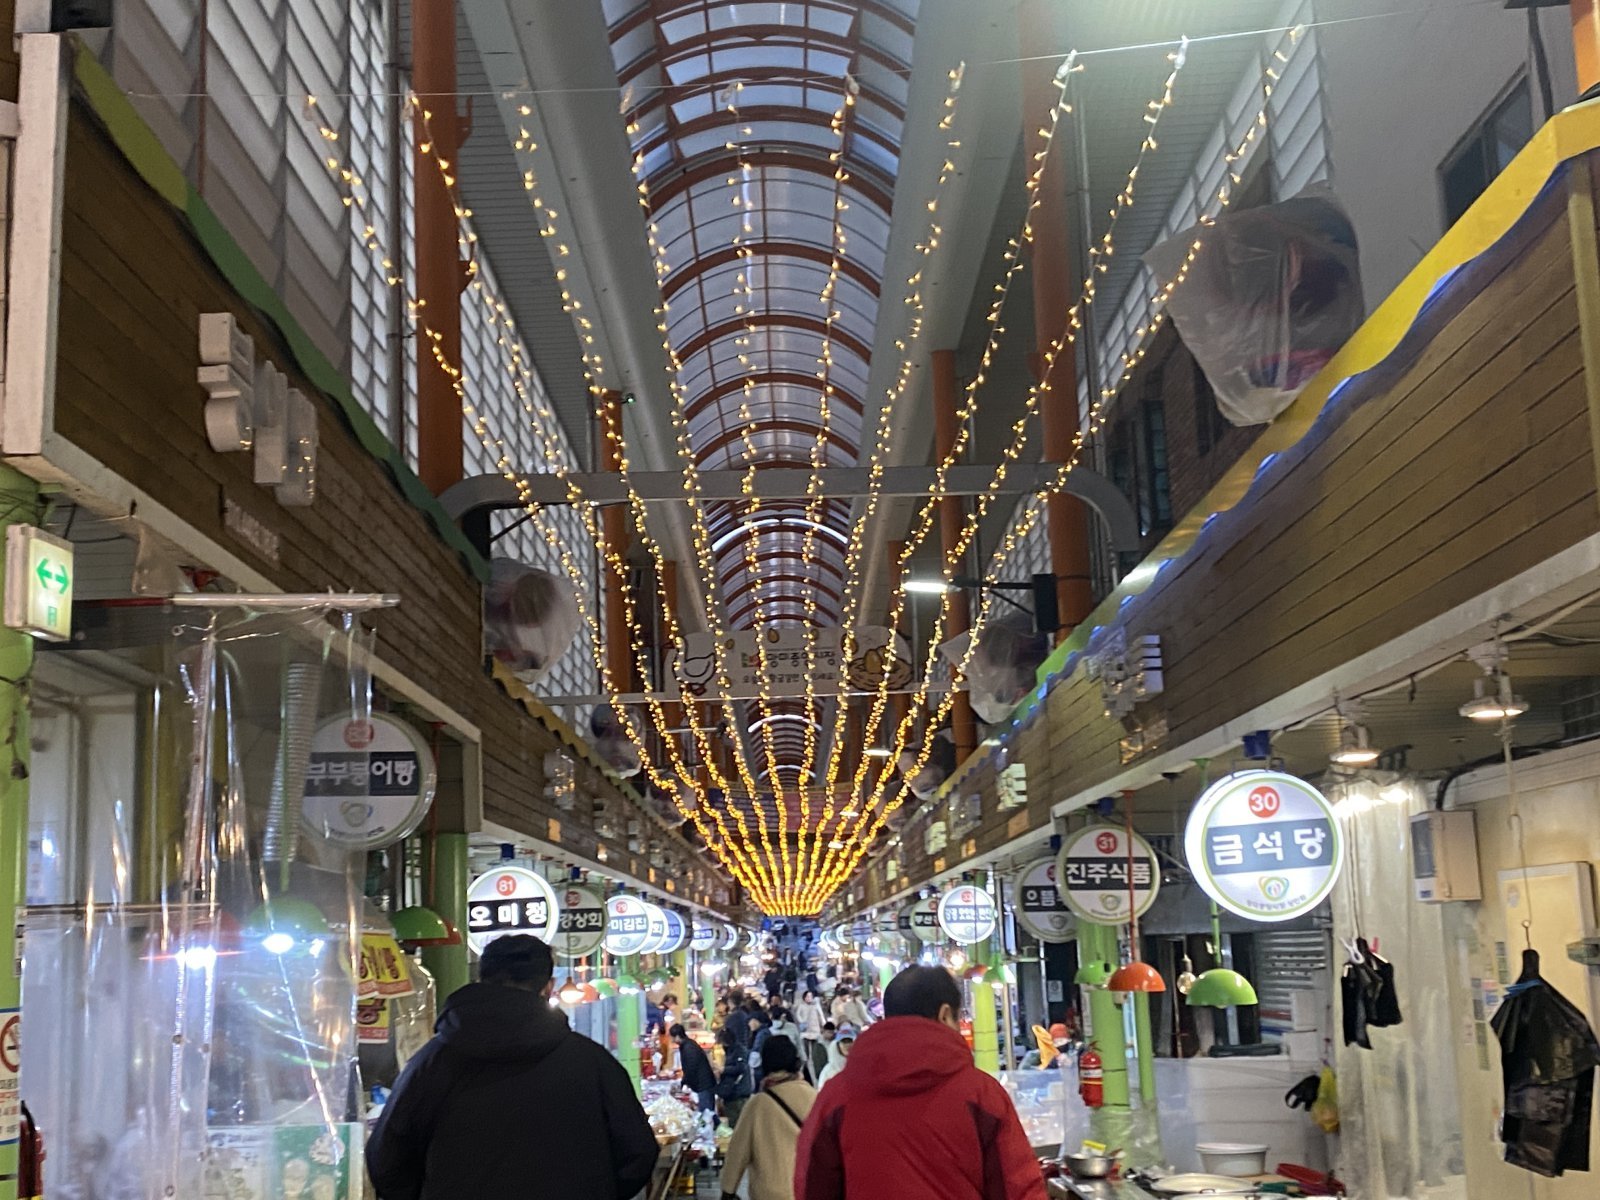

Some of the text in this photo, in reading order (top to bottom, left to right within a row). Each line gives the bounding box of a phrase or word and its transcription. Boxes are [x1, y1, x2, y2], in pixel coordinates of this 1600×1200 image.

[1251, 792, 1278, 812] 30
[1099, 837, 1113, 849] 31
[1212, 827, 1326, 866] 금석당
[1066, 863, 1150, 885] 진주식품
[498, 880, 514, 892] 81
[1025, 890, 1062, 907] 으뜸
[468, 901, 547, 933] 오미정
[559, 912, 602, 929] 강상회
[608, 916, 647, 932] 미김집
